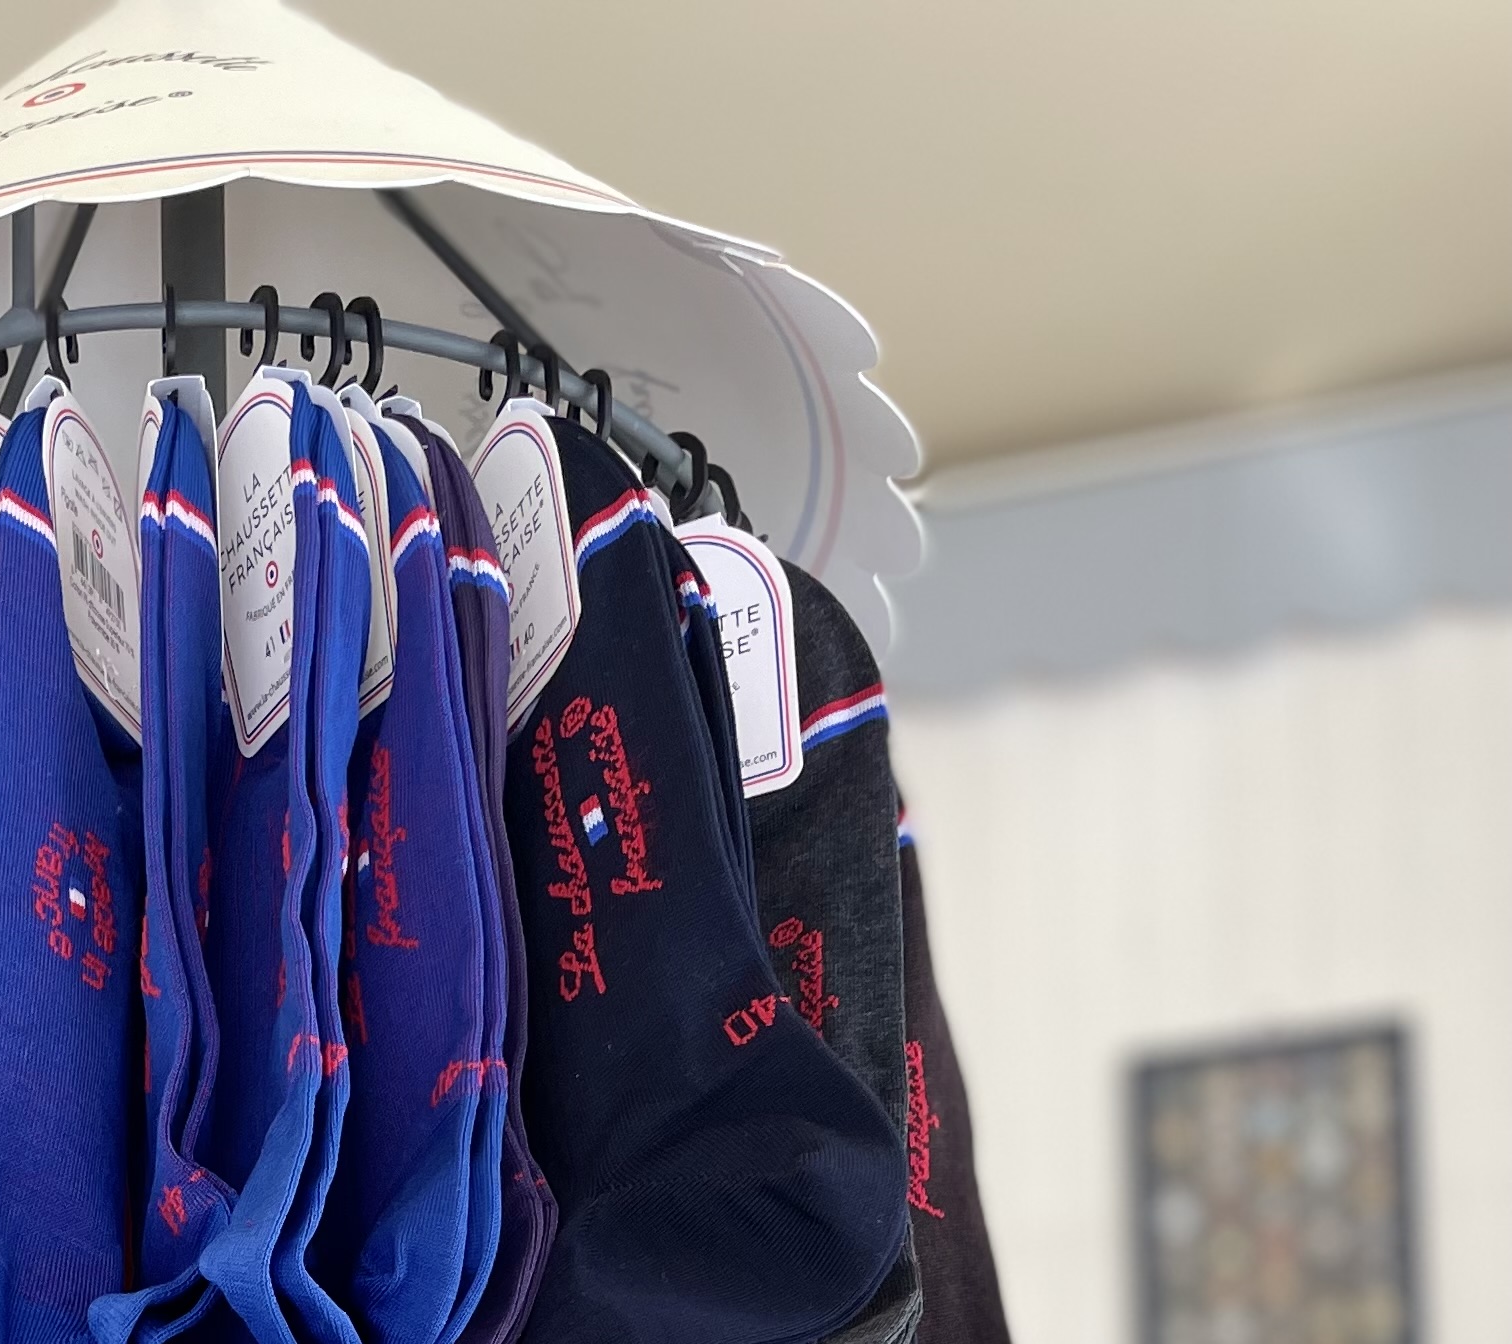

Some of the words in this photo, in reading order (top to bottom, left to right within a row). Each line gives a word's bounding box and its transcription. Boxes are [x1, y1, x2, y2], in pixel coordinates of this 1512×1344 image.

[221, 465, 293, 572] CHAUSSETT
[242, 471, 262, 504] LA
[494, 473, 545, 551] SSETTE
[227, 503, 295, 595] FRANÇAIS
[501, 499, 545, 577] ÇAISE®
[722, 994, 777, 1047] 40
